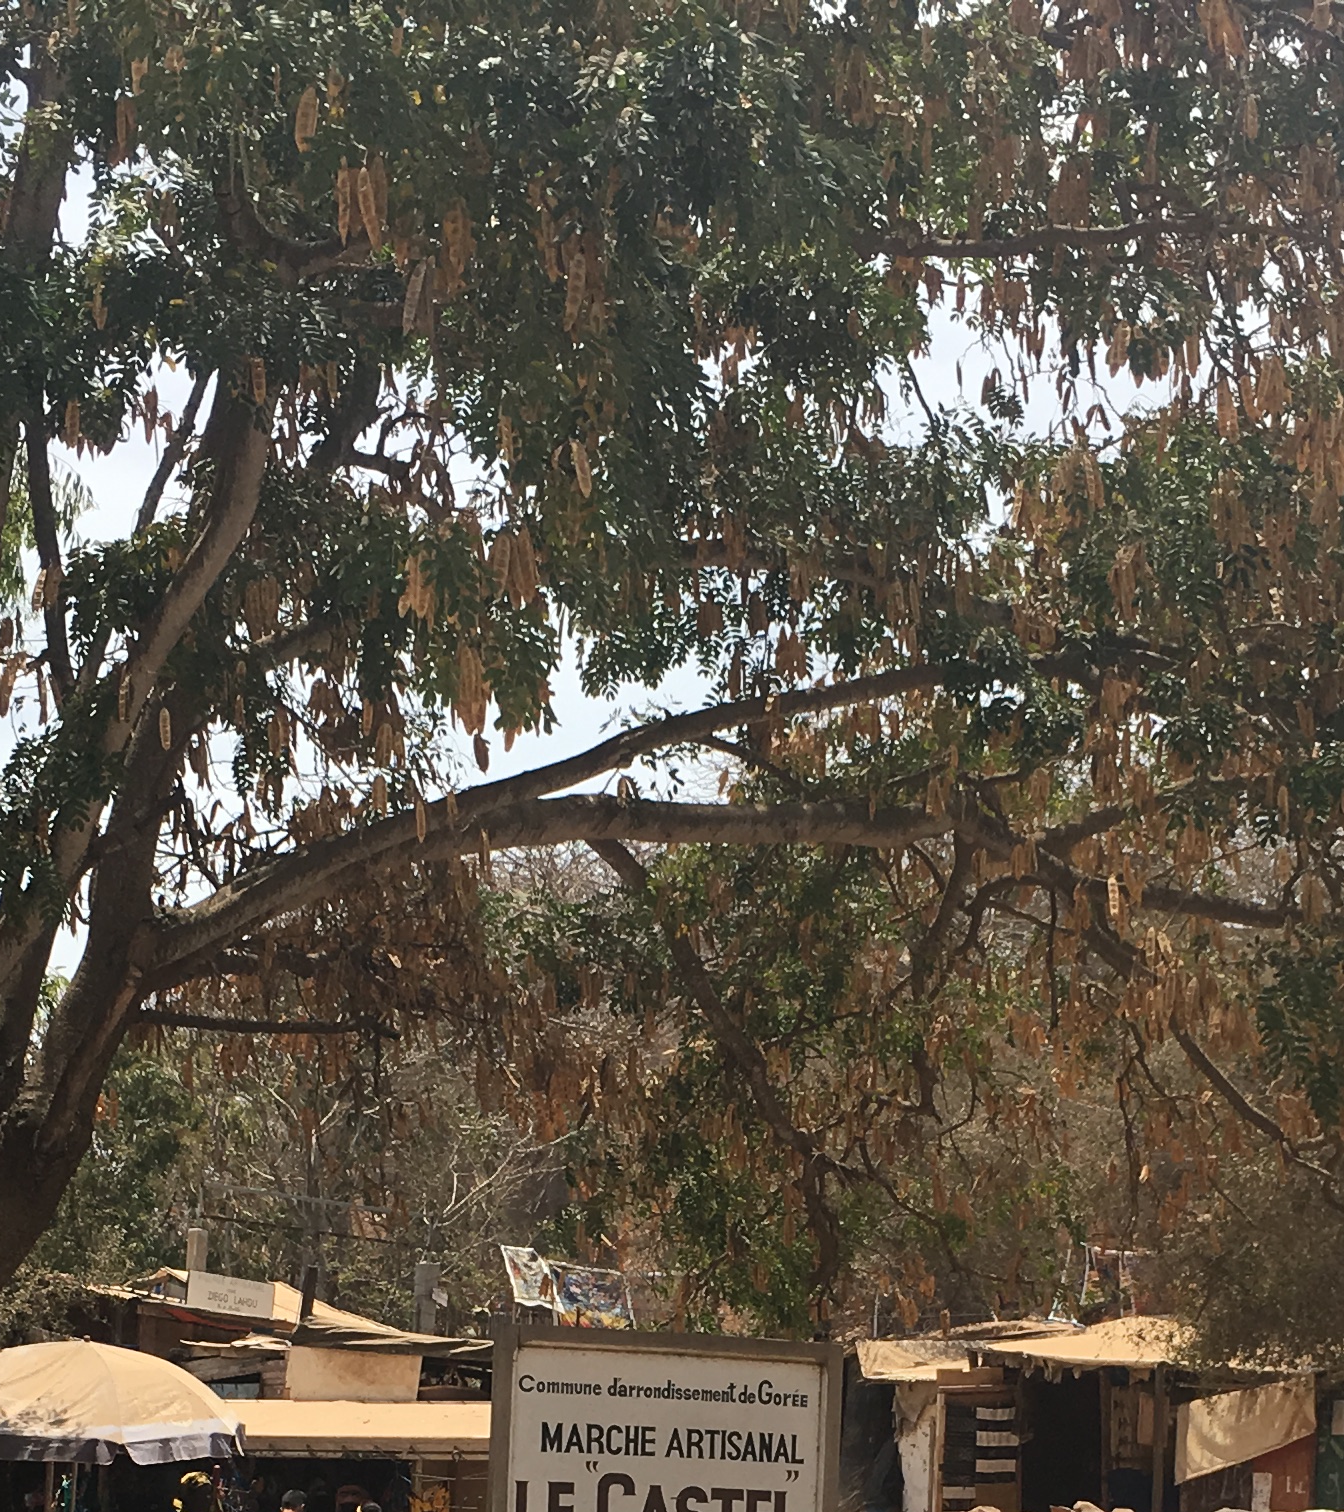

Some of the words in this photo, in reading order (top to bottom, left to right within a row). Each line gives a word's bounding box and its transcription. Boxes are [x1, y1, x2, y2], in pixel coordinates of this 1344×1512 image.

[518, 1374, 602, 1395] Commune
[607, 1377, 737, 1404] d'arrondissement
[739, 1385, 756, 1404] de
[541, 1421, 656, 1457] MARCHE
[665, 1428, 805, 1465] ARTISANAL
